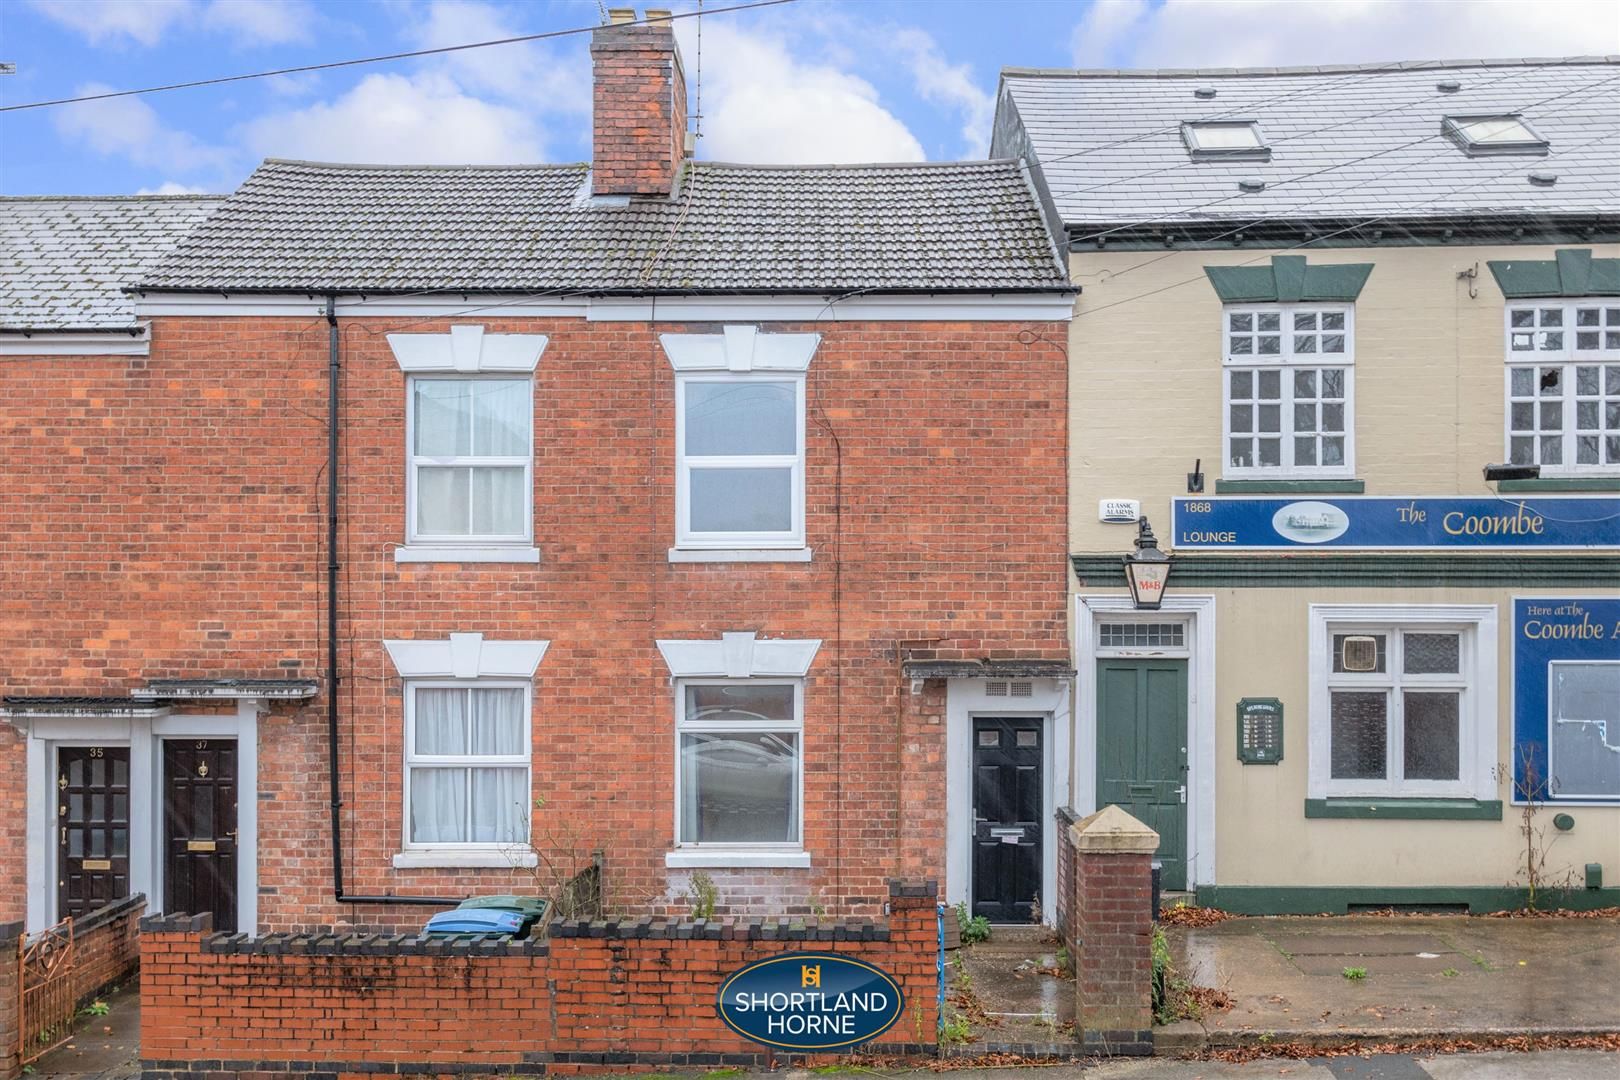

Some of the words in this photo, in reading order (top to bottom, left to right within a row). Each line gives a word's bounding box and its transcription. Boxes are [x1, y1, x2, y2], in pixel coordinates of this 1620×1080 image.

[1183, 502, 1212, 513] 1868
[1396, 501, 1427, 525] The
[1443, 501, 1544, 535] Coombe
[1183, 531, 1237, 543] LOUNGE
[1139, 580, 1161, 590] M&B
[1527, 605, 1552, 616] Here
[1524, 611, 1604, 640] Coombe
[195, 740, 208, 750] 37
[89, 747, 104, 758] 35
